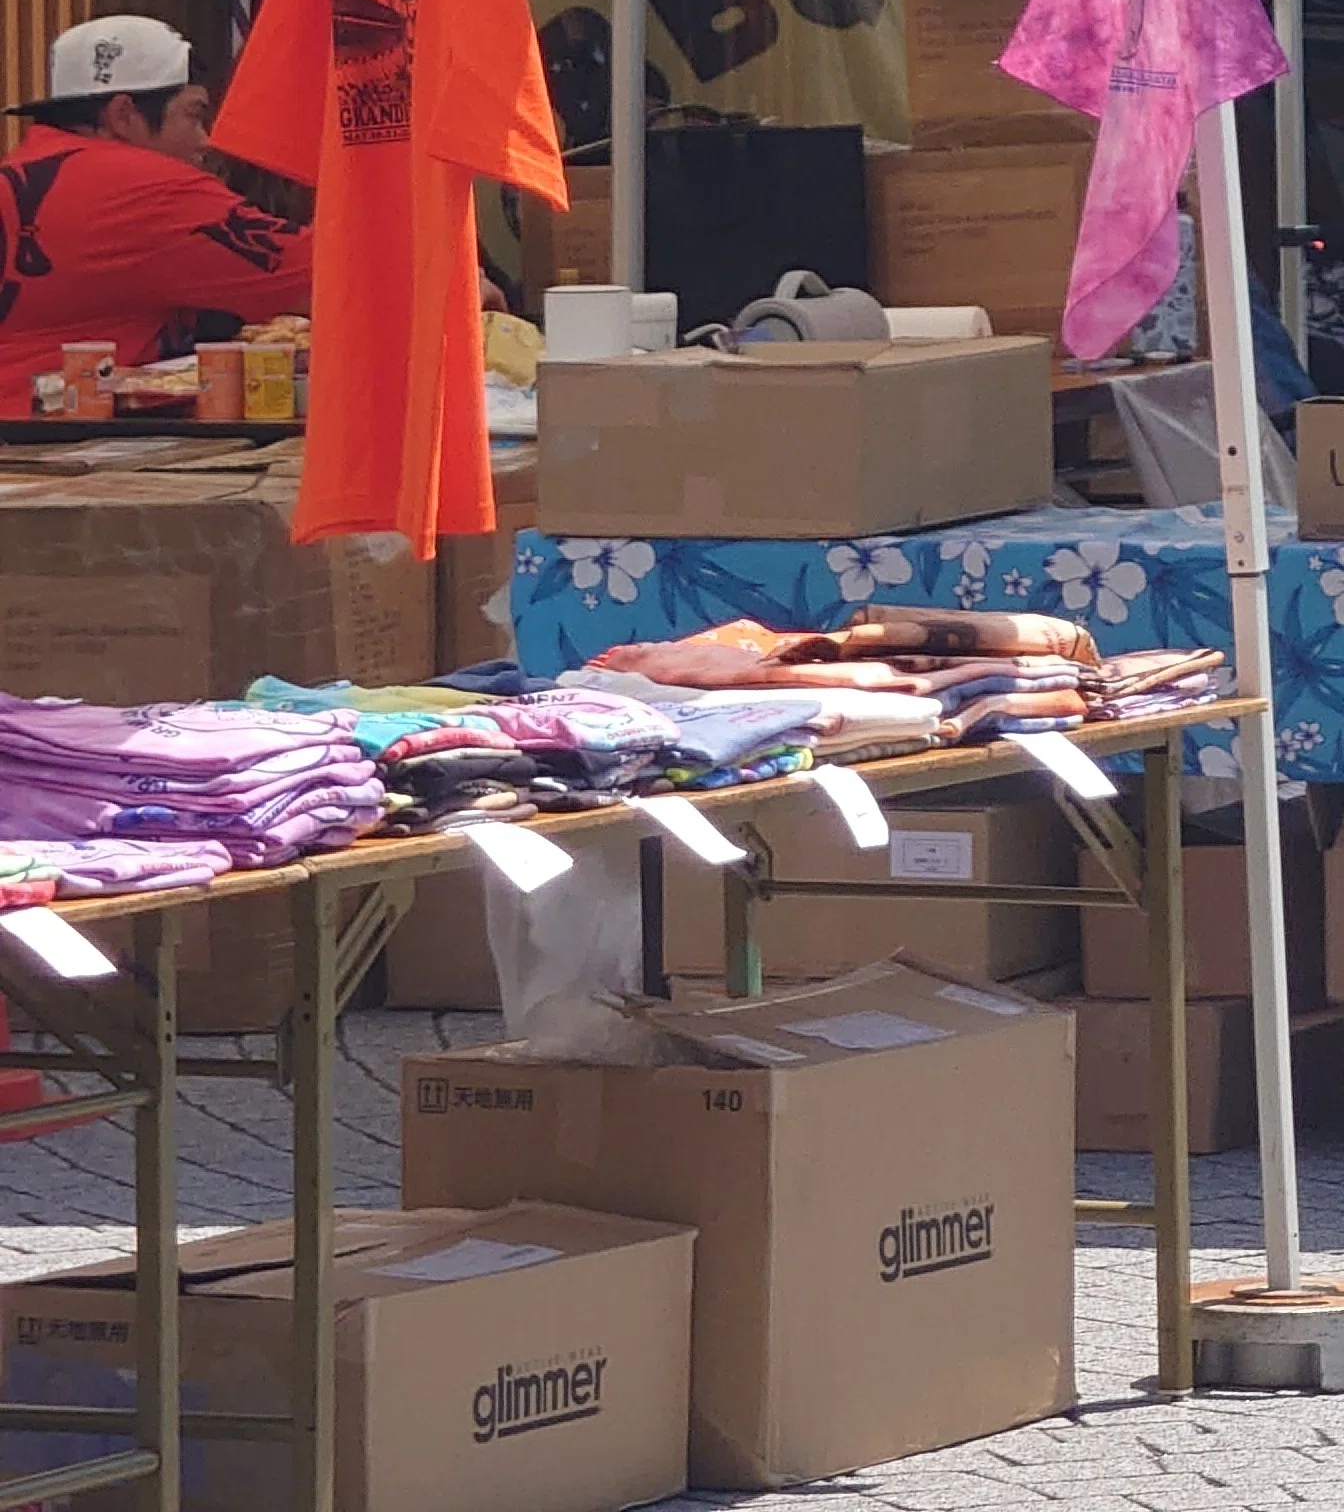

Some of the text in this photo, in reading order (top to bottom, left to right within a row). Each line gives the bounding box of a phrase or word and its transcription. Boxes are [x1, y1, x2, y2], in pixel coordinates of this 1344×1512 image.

[702, 1088, 743, 1112] 140
[879, 1204, 994, 1283] glimmer
[472, 1357, 608, 1444] glimmer
